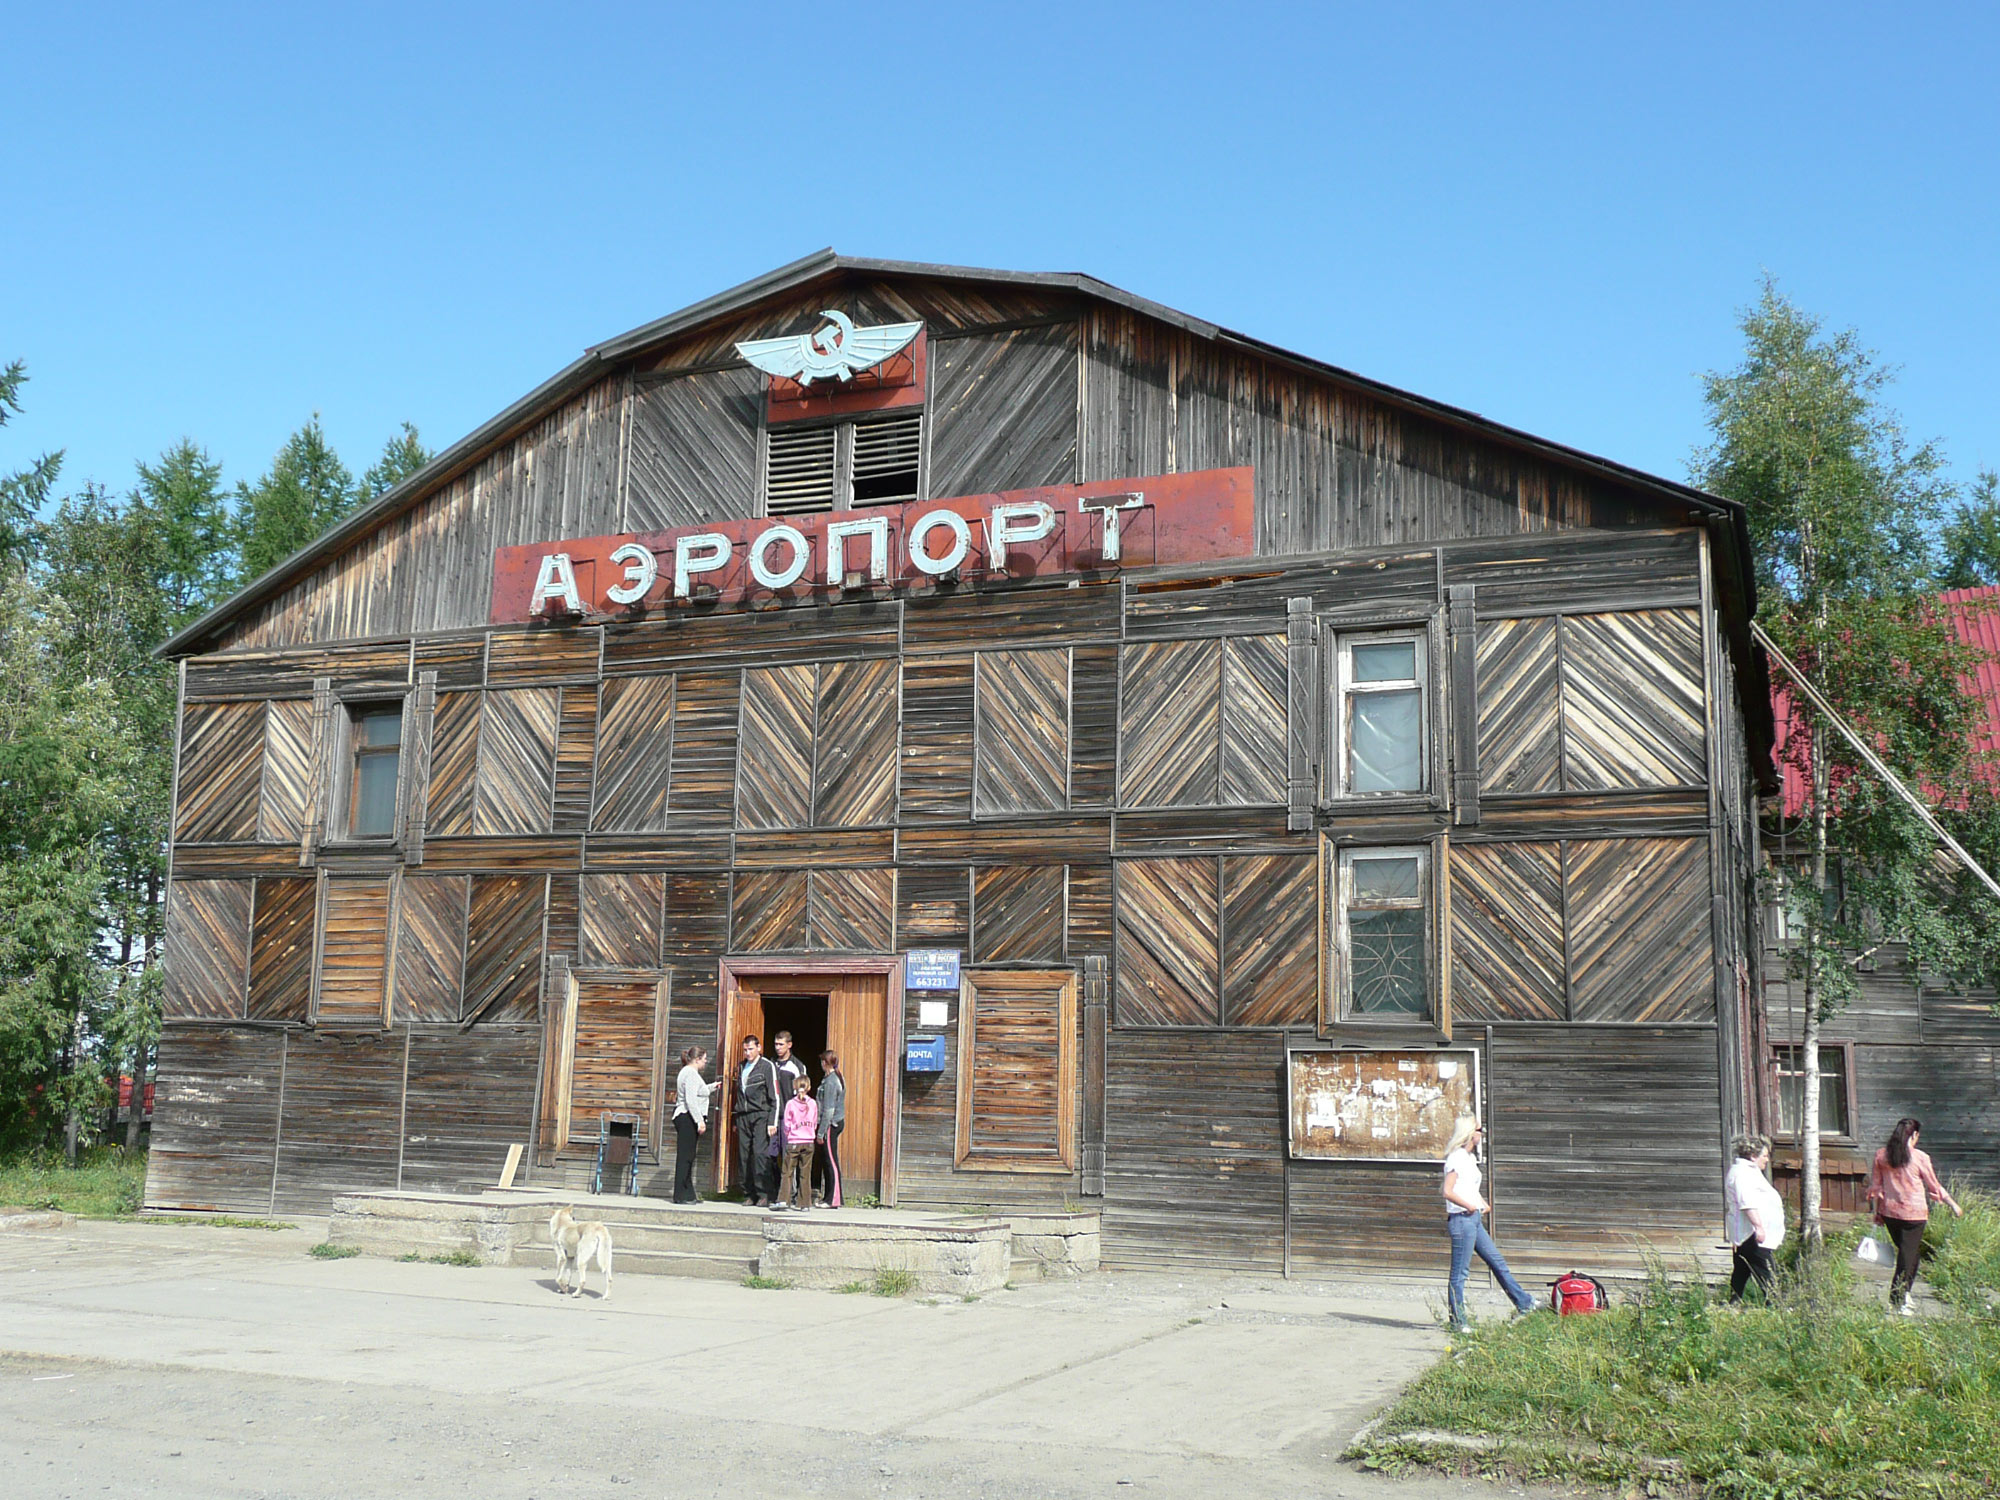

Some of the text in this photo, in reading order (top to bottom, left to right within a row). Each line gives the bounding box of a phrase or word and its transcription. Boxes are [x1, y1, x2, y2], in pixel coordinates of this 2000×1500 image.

[529, 492, 1145, 616] АЭРОПОРТ
[916, 977, 947, 986] 663231
[908, 1050, 933, 1058] ПОЧТА
